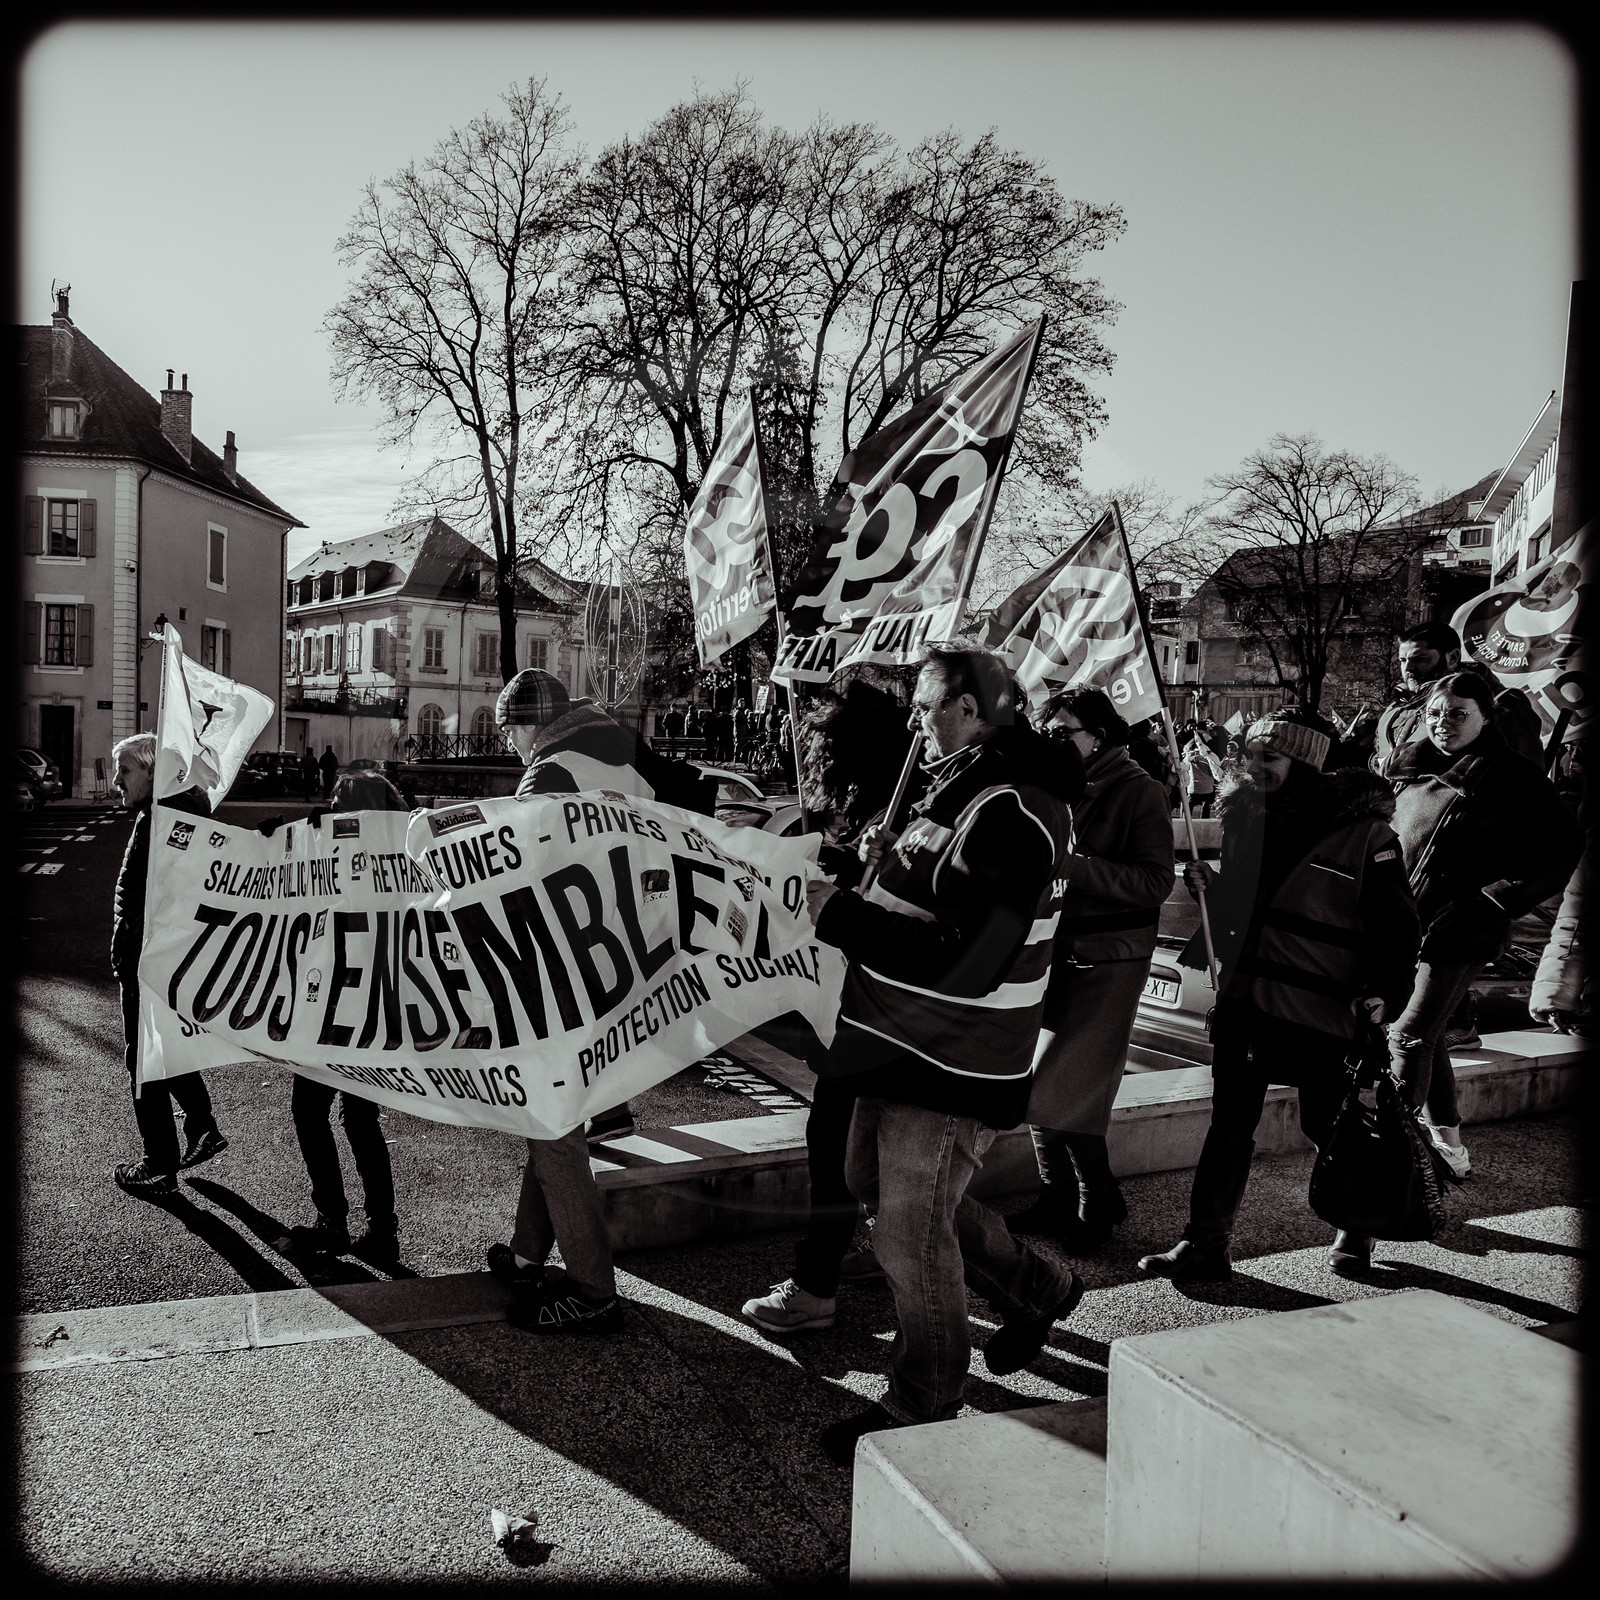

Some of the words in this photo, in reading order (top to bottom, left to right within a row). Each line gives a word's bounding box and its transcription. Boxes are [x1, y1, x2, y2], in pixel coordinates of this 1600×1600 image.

[171, 829, 193, 843] cgt
[203, 860, 276, 900] SALARIÉS
[563, 801, 667, 844] PRIVÉS
[434, 811, 481, 831] Solidaires
[167, 903, 311, 1042] TOUS
[317, 845, 726, 1052] ENSEMBLE
[326, 1063, 427, 1096] SERVICES
[425, 1064, 527, 1107] PUBLICS
[578, 963, 711, 1088] PROTECTION
[716, 945, 820, 989] SOCIALE
